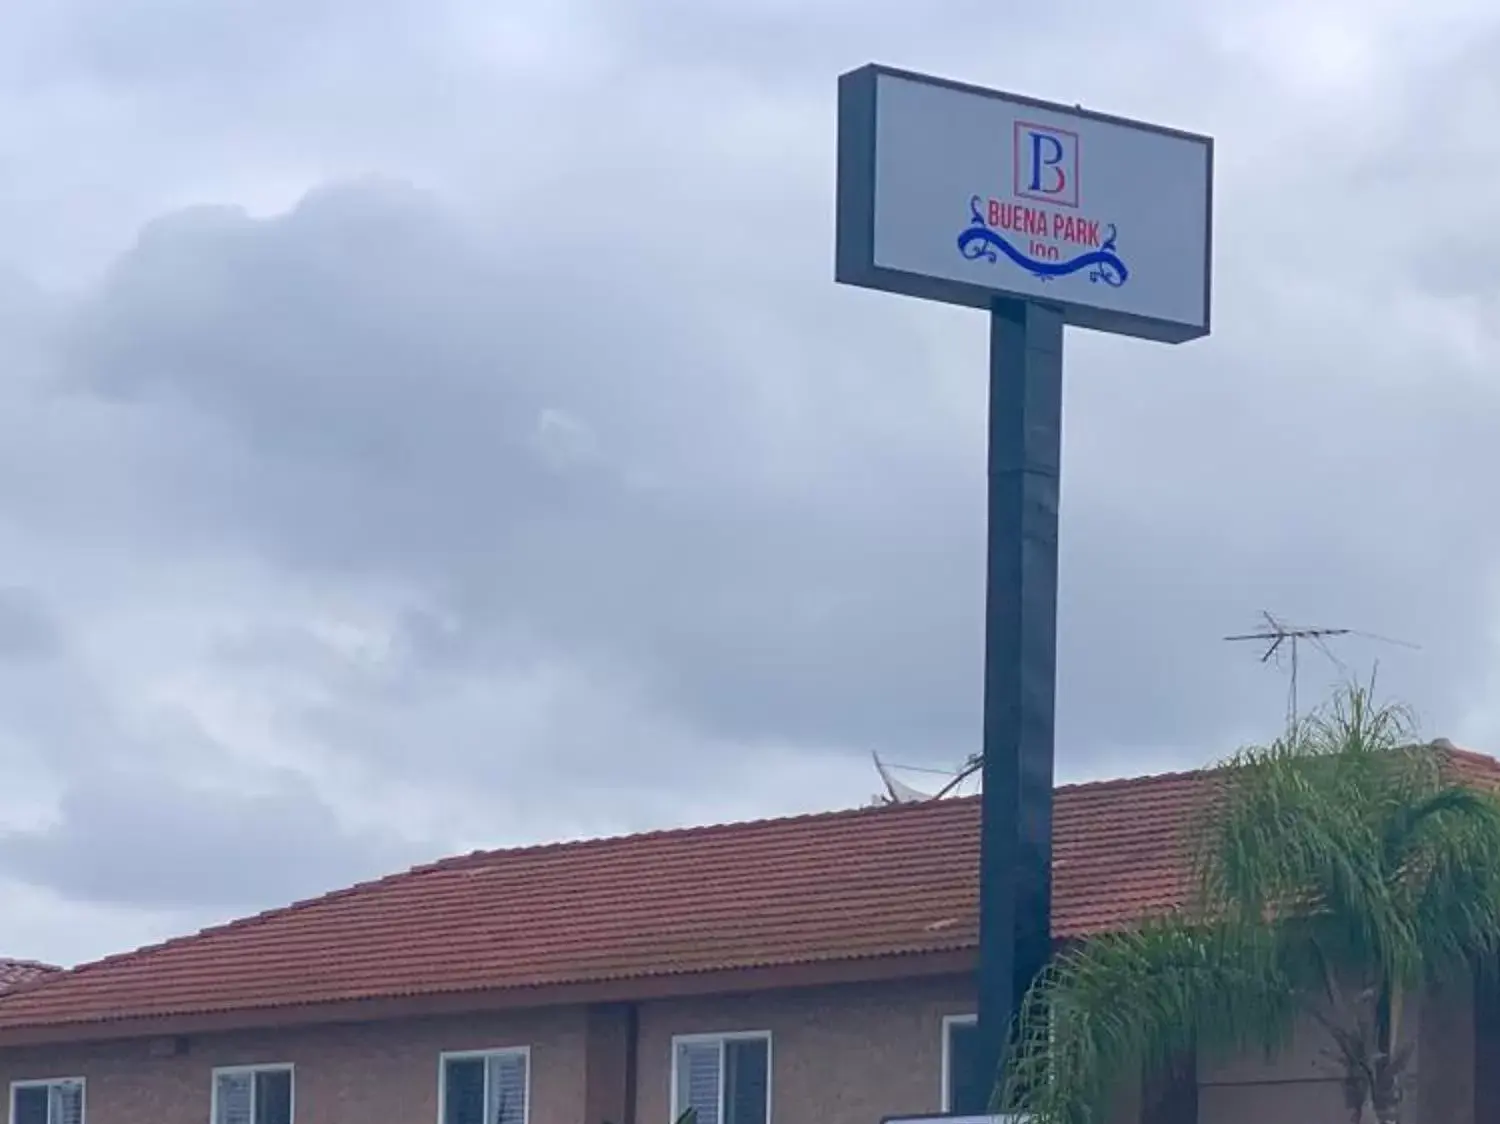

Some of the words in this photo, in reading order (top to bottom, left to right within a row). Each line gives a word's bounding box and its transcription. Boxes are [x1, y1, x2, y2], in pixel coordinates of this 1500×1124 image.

[1028, 131, 1065, 194] B
[988, 199, 1047, 236] BUENA
[1054, 213, 1100, 248] PARK
